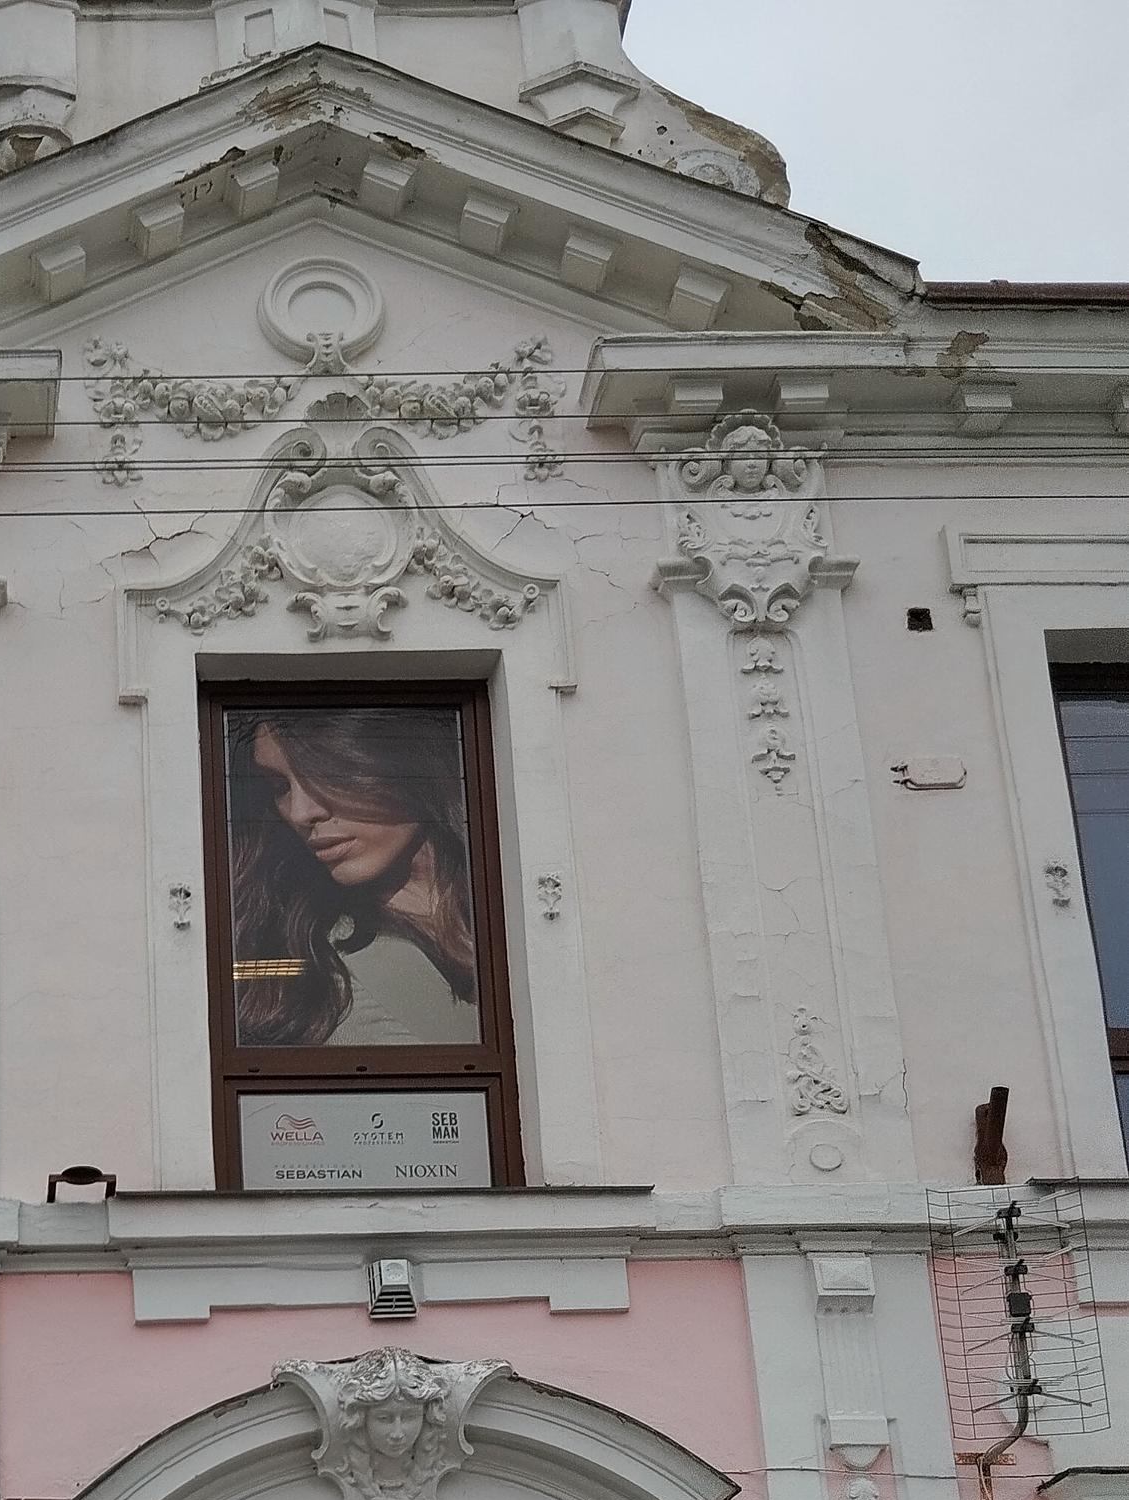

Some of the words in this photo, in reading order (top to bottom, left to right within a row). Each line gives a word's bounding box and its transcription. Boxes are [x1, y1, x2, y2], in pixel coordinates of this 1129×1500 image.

[431, 1112, 458, 1126] SEB
[271, 1131, 324, 1141] WELLA
[353, 1132, 404, 1141] SYSTEM
[432, 1126, 459, 1139] MAN
[275, 1169, 363, 1180] SEBASTIAN
[395, 1164, 458, 1178] NIOXIN
